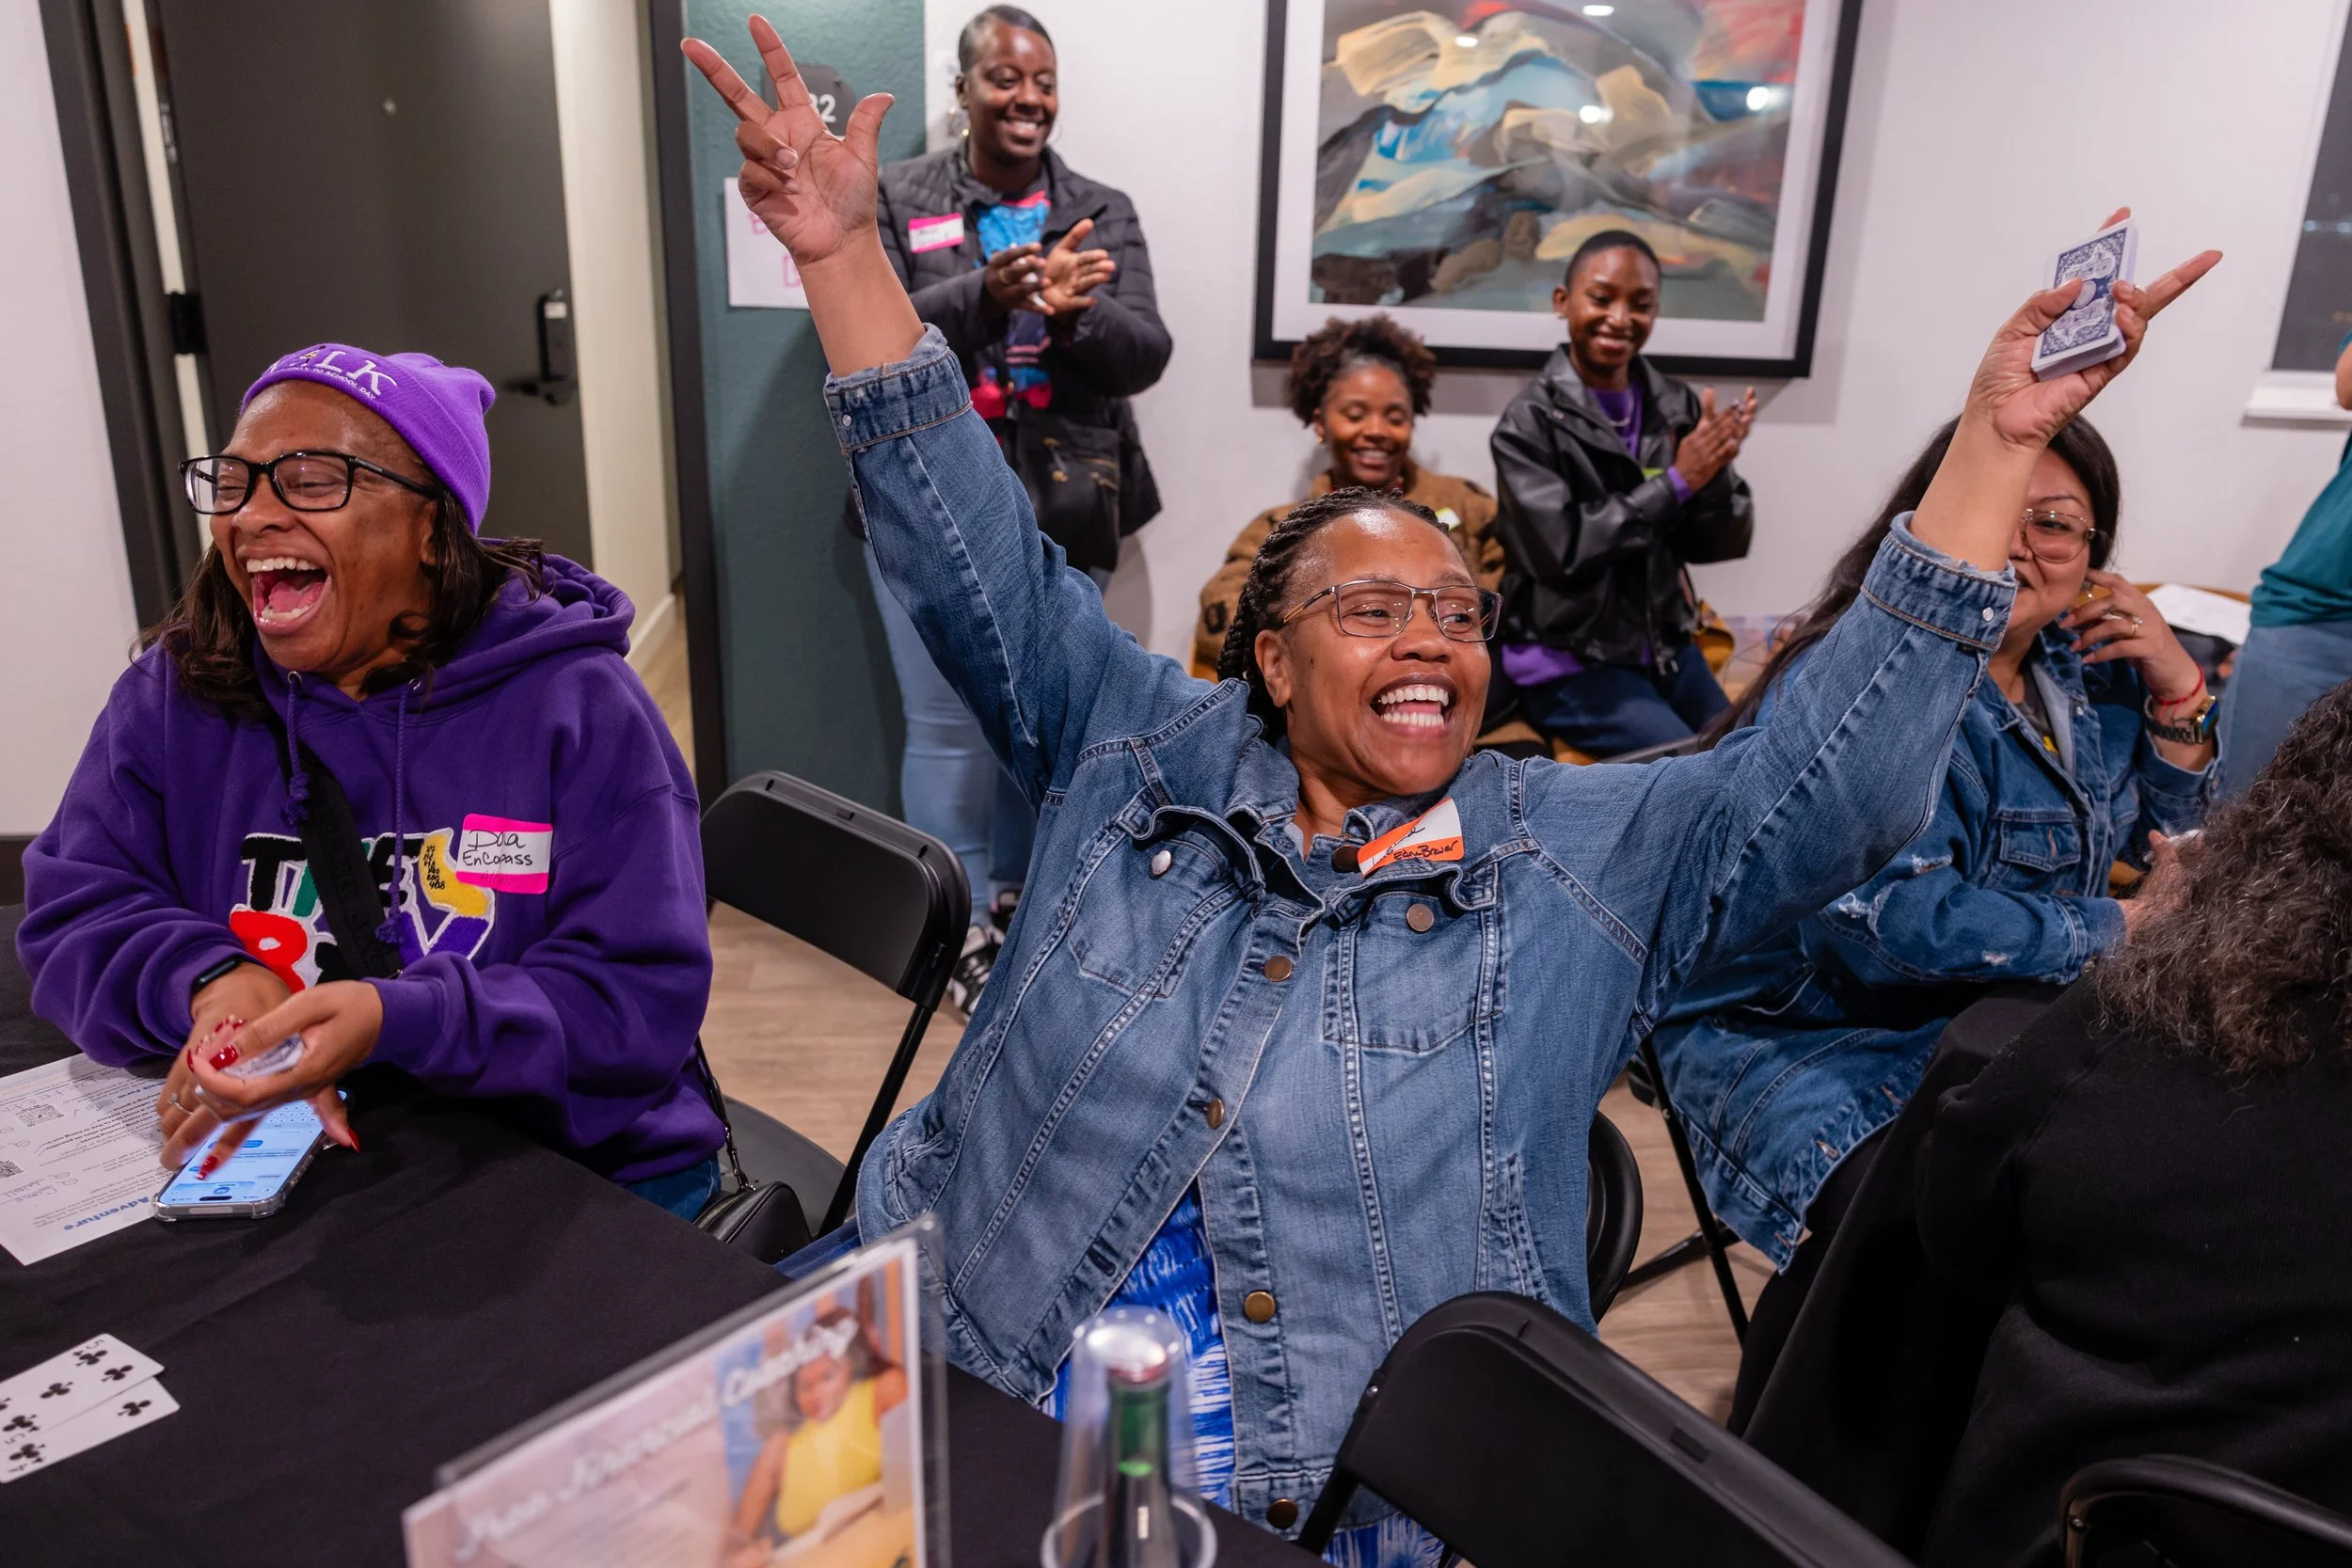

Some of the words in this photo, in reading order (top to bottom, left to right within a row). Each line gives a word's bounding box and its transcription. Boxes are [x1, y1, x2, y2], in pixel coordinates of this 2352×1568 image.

[324, 370, 358, 389] SCHOOL
[359, 387, 378, 400] DAY
[63, 1196, 150, 1230] Adventure
